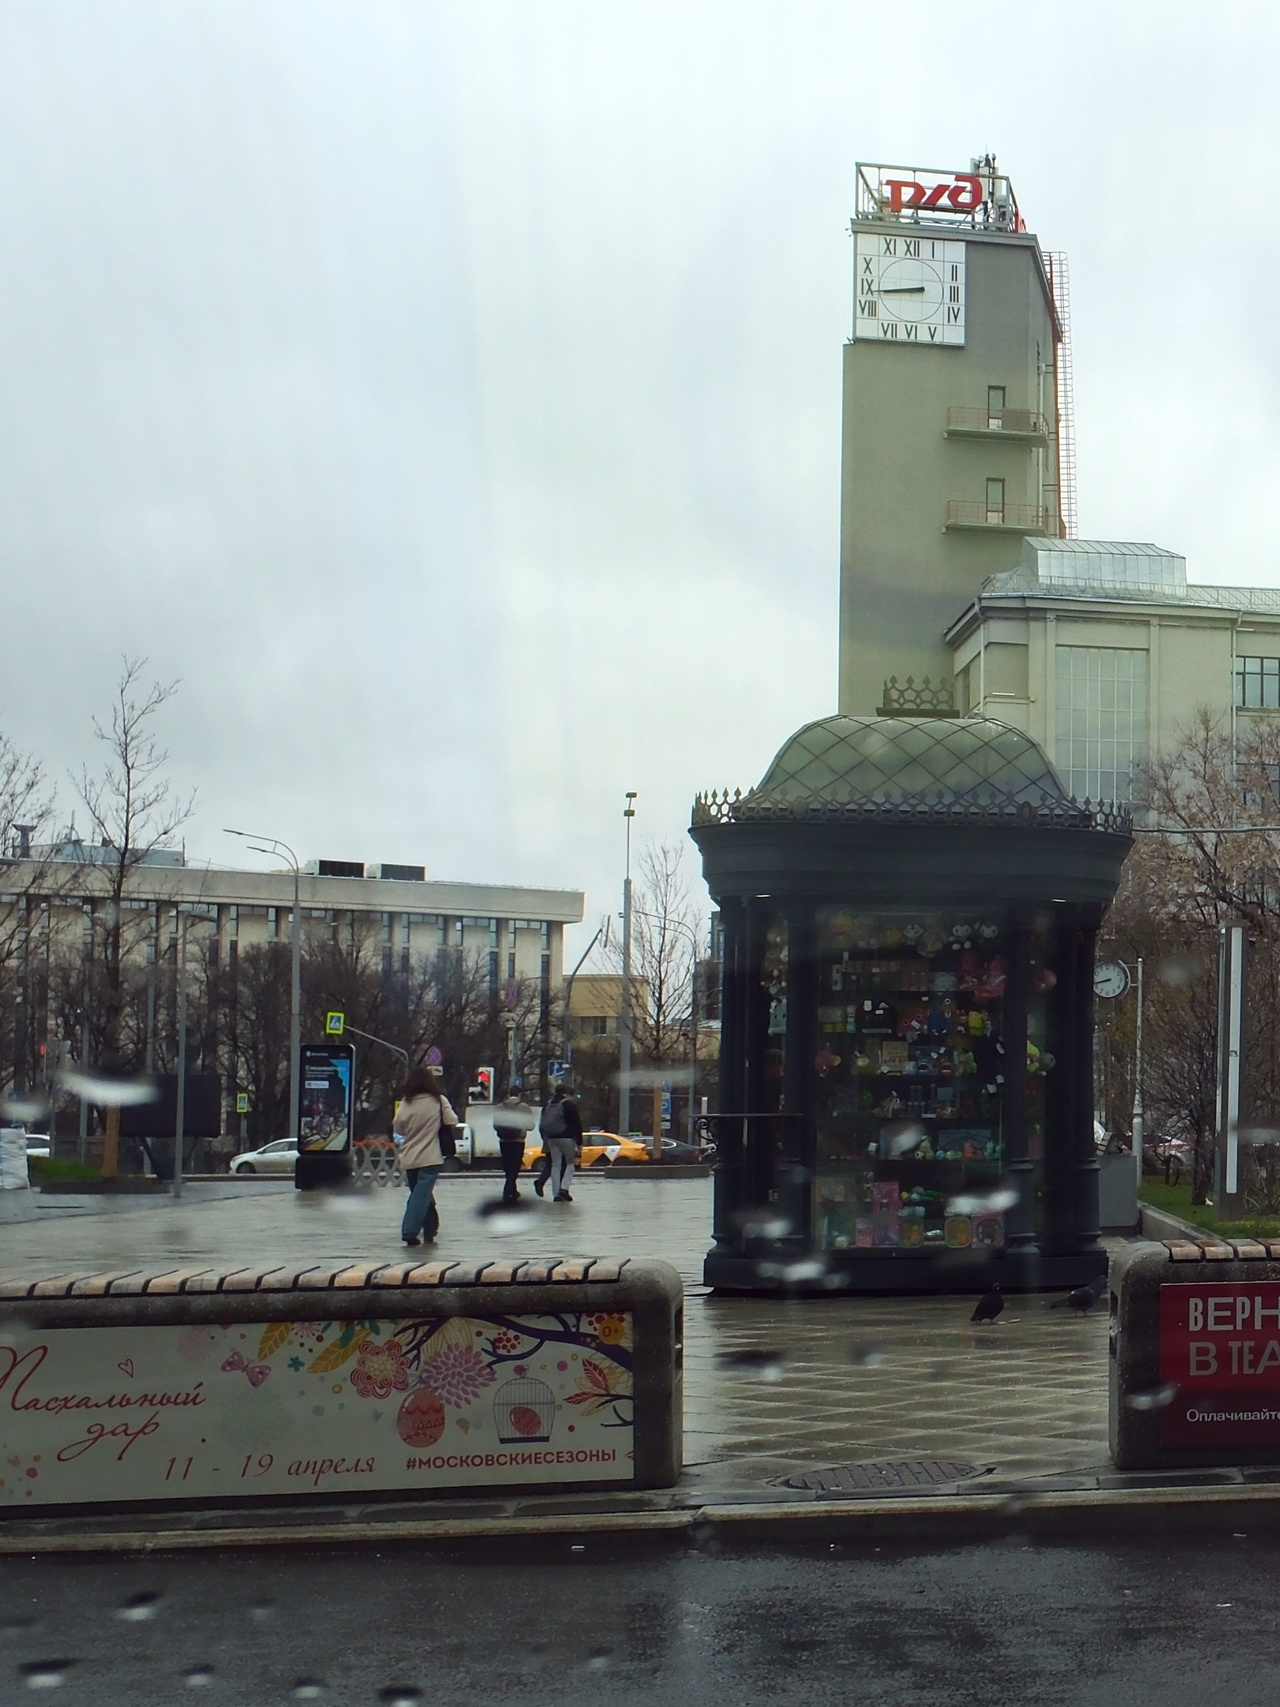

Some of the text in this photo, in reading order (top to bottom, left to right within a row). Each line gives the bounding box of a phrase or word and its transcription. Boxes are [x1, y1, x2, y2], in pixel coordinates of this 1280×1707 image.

[884, 237, 897, 255] XI
[904, 239, 920, 258] XII
[863, 257, 873, 275] X
[951, 264, 958, 282] II
[861, 278, 874, 296] IX
[949, 285, 959, 303] III
[858, 299, 877, 318] VIII
[947, 306, 960, 323] IV
[881, 322, 898, 338] VII
[904, 323, 918, 340] VI
[928, 326, 937, 341] V
[602, 1326, 620, 1338] 0+
[1189, 1341, 1217, 1376] В
[56, 1411, 160, 1462] дар
[405, 1449, 616, 1471] #МОСКОВСКИЕСЕЗОНЫ
[165, 1456, 194, 1481] 11
[241, 1453, 274, 1478] 19
[287, 1456, 377, 1487] апреля
